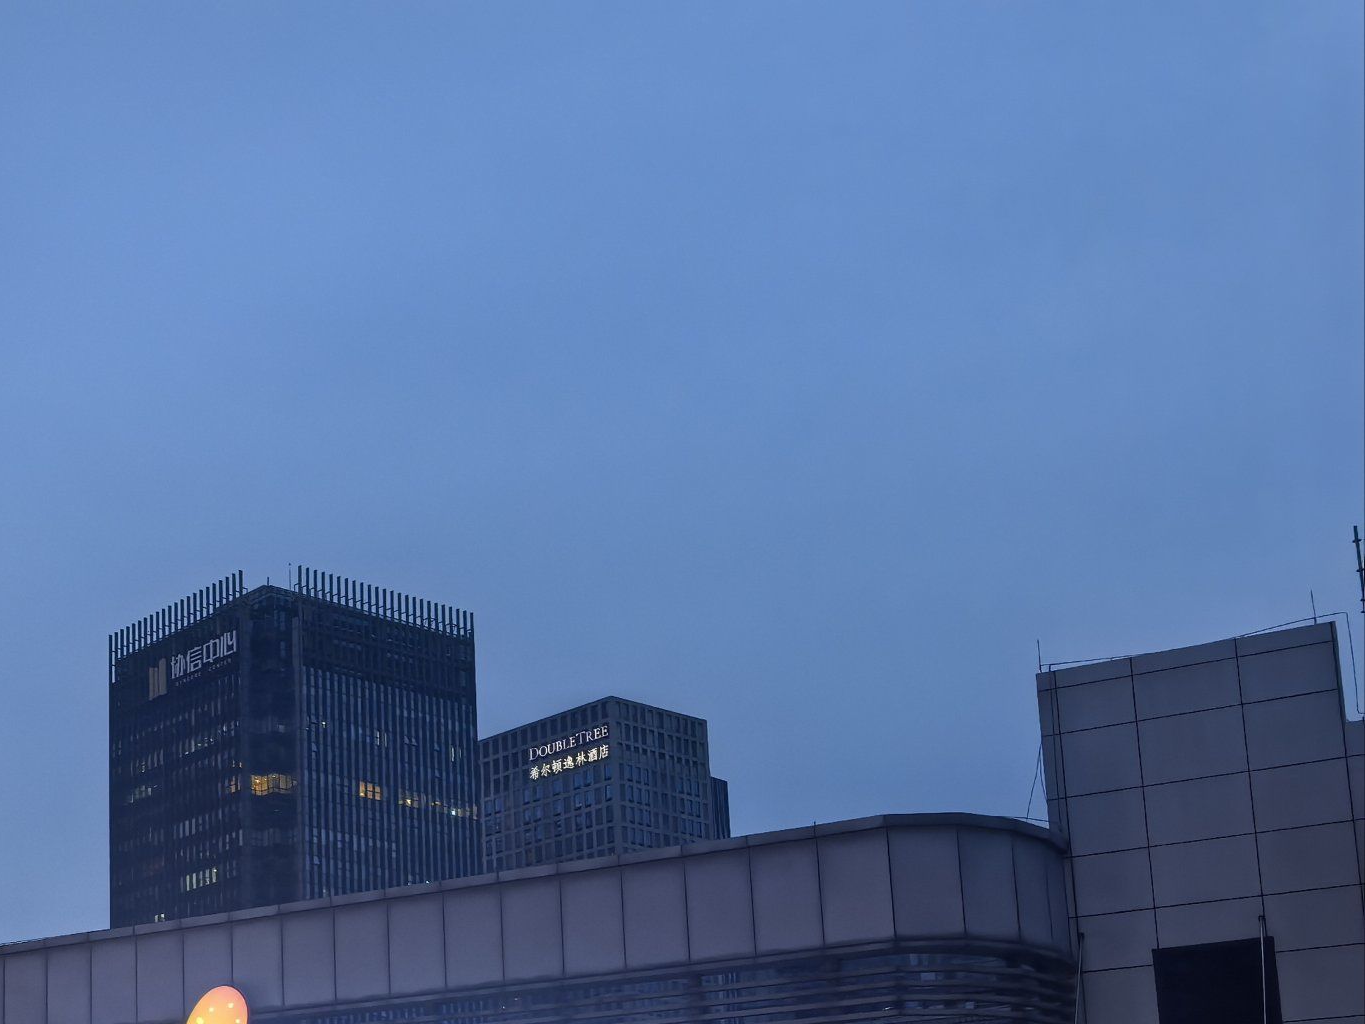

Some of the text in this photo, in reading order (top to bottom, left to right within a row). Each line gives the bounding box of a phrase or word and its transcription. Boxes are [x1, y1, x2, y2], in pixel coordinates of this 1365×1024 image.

[171, 630, 237, 679] 协信中心
[529, 744, 609, 780] 希尔顿逸林酒店
